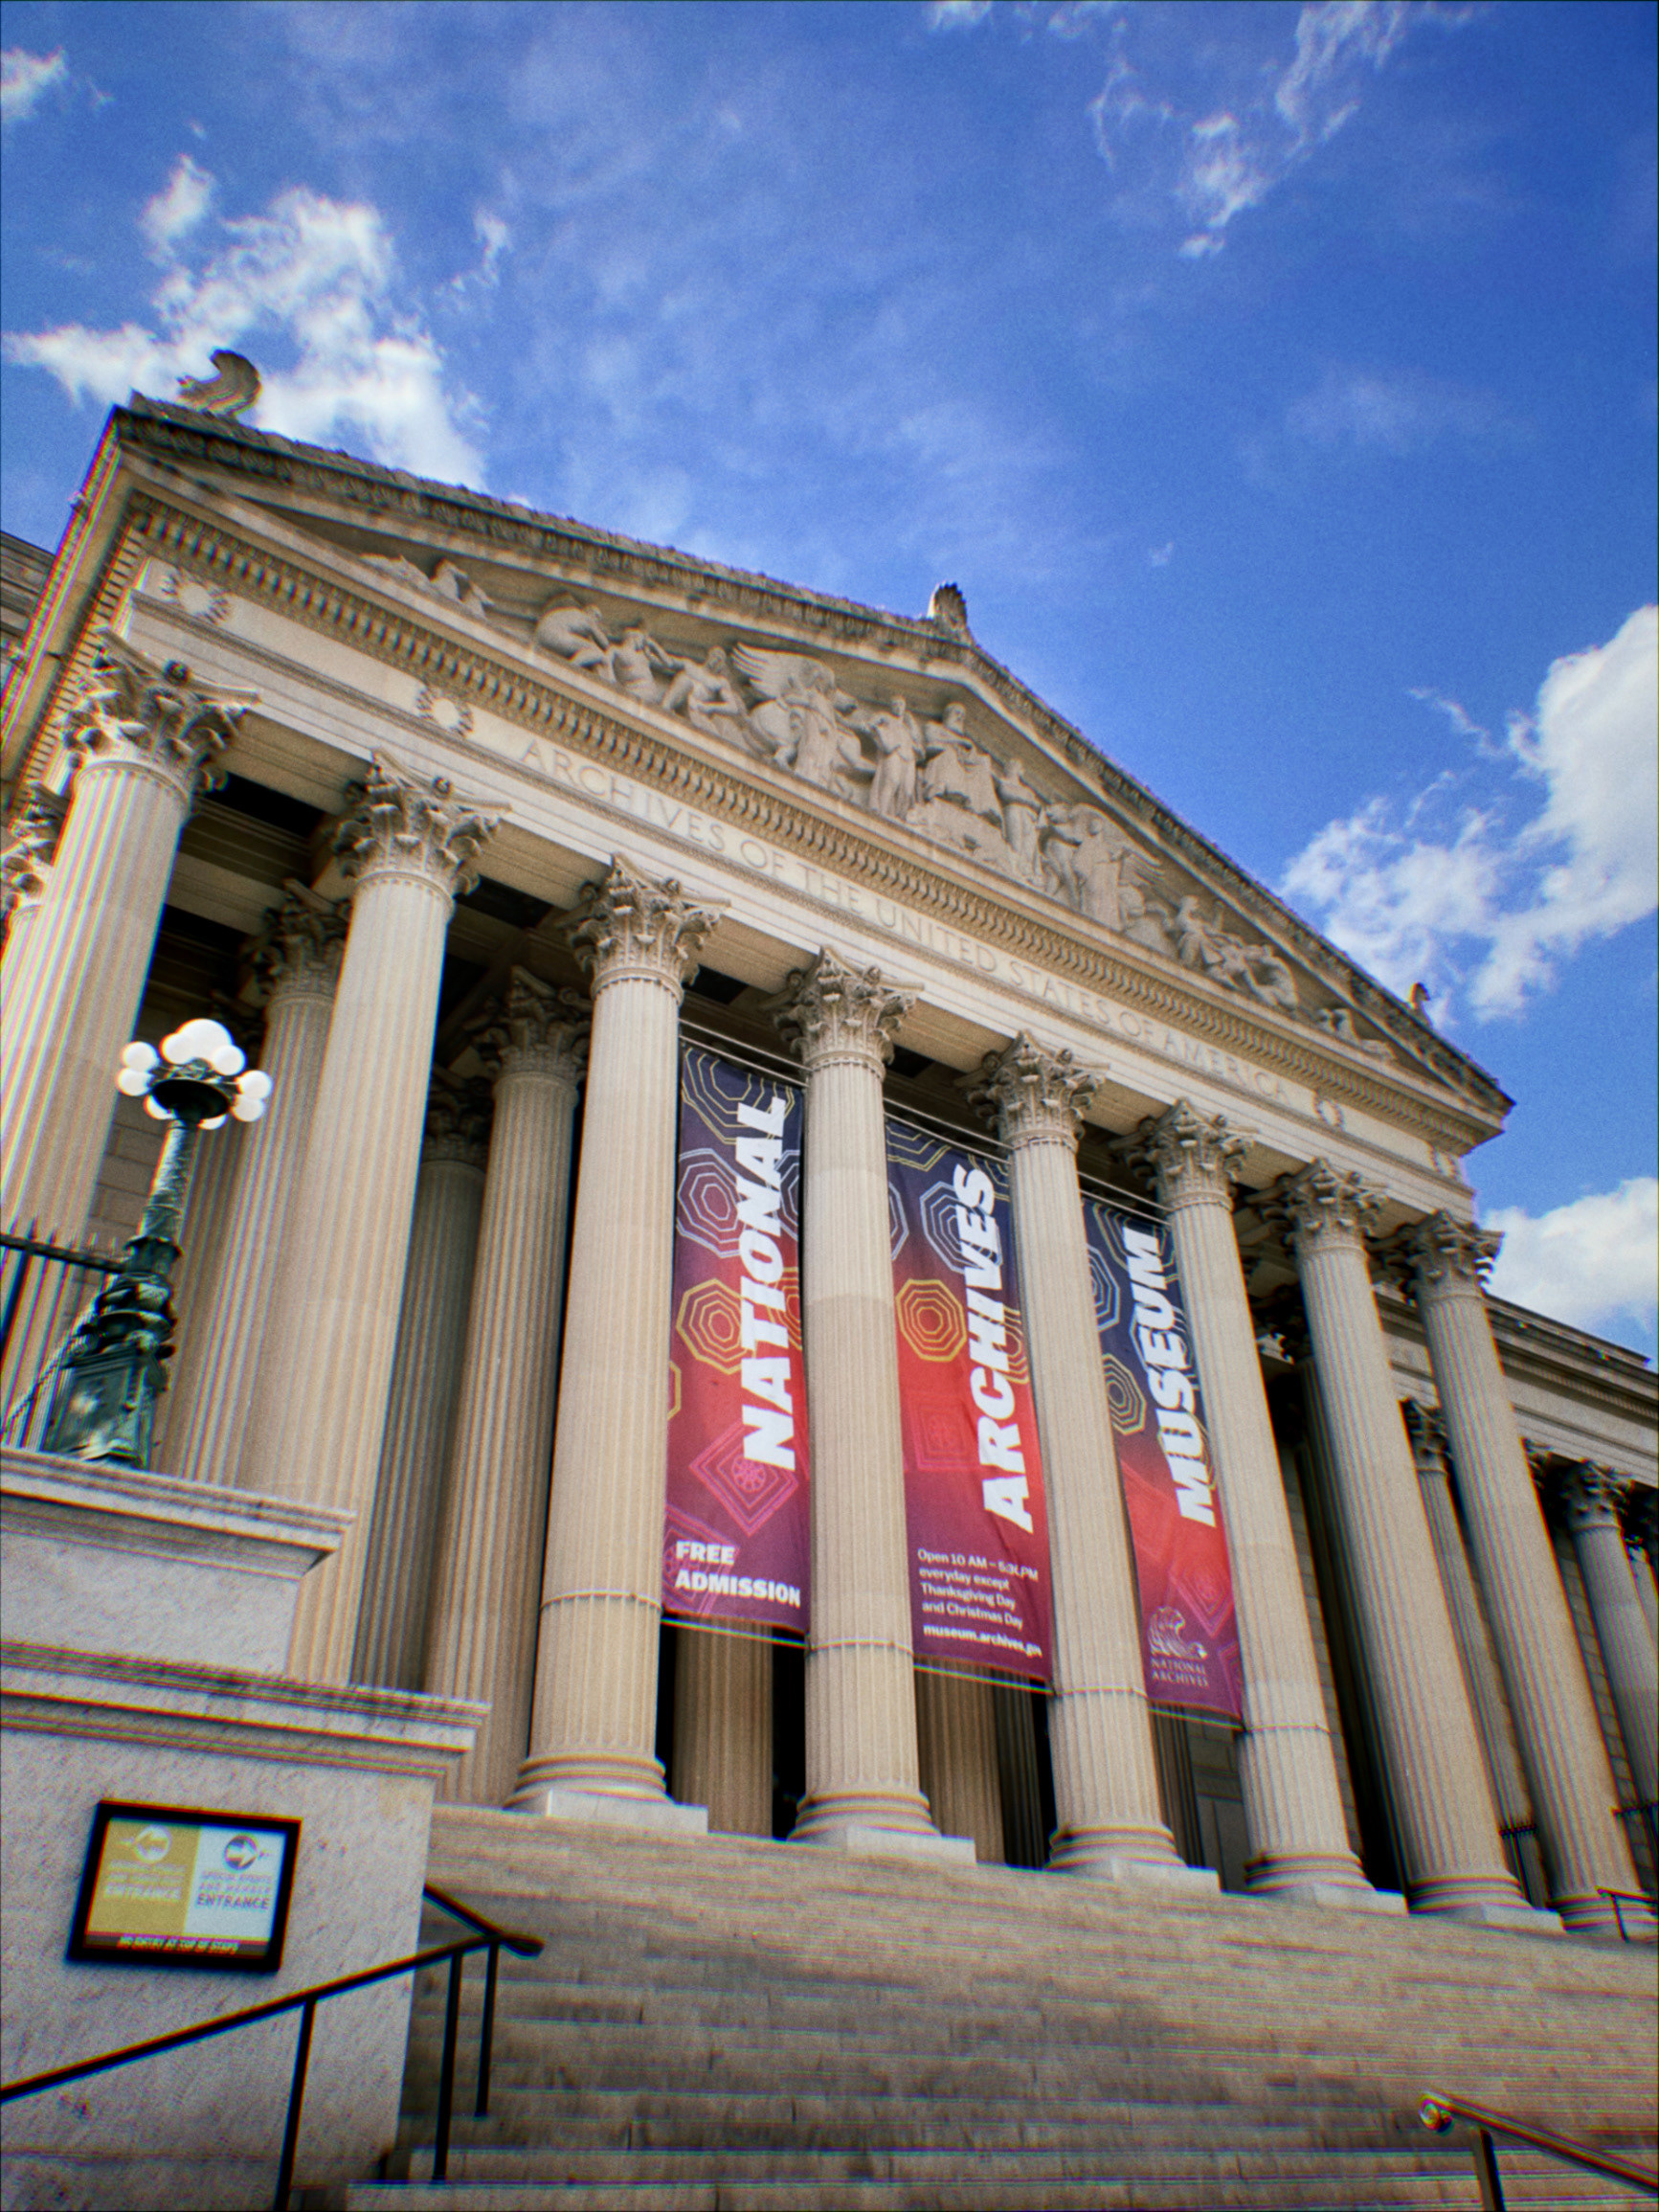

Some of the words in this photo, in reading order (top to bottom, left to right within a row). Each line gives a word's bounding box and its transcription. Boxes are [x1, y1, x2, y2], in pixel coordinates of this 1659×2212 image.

[521, 738, 727, 852] ARCHIVES
[740, 839, 789, 878] OF
[801, 867, 860, 913] THE
[876, 899, 998, 972] UNITED
[1009, 962, 1110, 1029] STATES
[1117, 1009, 1155, 1043] OF
[1160, 1028, 1292, 1102] AMERICA
[736, 1096, 796, 1471] NATIONAL
[953, 1164, 1033, 1534] ARCHIVES
[1124, 1227, 1216, 1526] MUSEUM
[676, 1539, 735, 1566] FREE
[917, 1547, 950, 1564] Open
[951, 1553, 966, 1567] 10
[968, 1554, 988, 1569] AM
[674, 1568, 801, 1610] ADMISSION
[919, 1567, 972, 1586] everyday
[973, 1574, 1010, 1591] except
[920, 1581, 996, 1608] Thanksgiving
[996, 1592, 1017, 1612] Day
[922, 1600, 945, 1614] and
[946, 1601, 1003, 1625] Christmas
[1003, 1612, 1023, 1632] Day
[1151, 1657, 1207, 1676] NATIONAL
[1152, 1670, 1209, 1688] ARCHIVES
[196, 1892, 270, 1911] ENTRANCE
